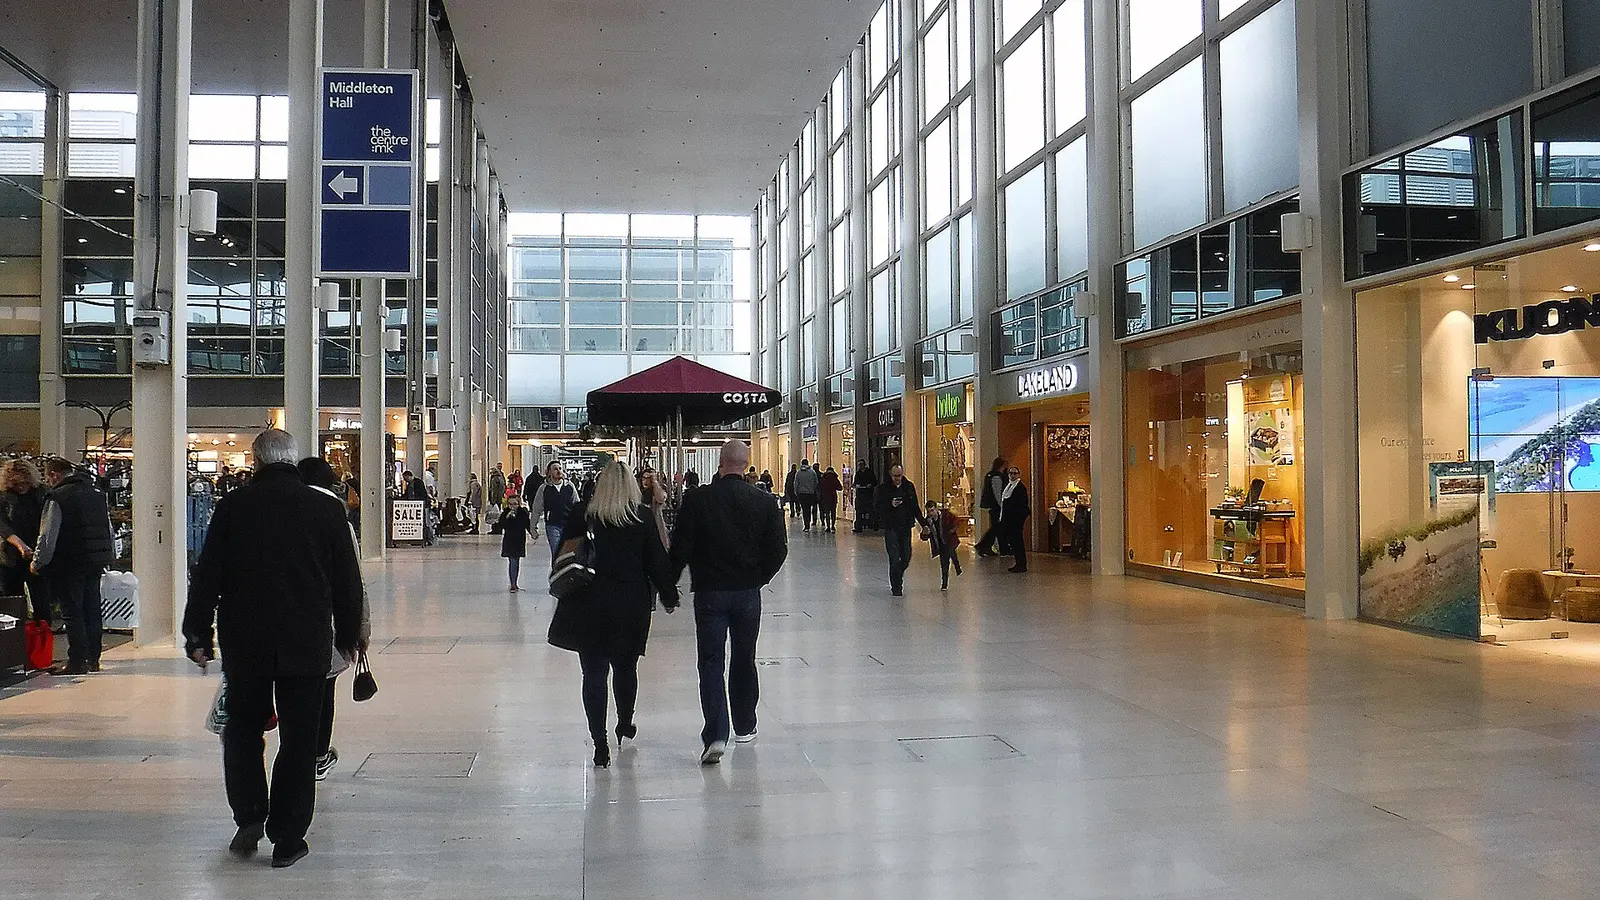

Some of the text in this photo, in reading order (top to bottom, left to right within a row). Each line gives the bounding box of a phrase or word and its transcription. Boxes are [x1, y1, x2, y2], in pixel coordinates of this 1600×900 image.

[330, 82, 394, 94] Middleton
[330, 97, 353, 108] Hall
[370, 125, 391, 137] the
[370, 135, 409, 146] centre
[371, 143, 394, 154] :mk
[1017, 364, 1078, 398] LAKELAND
[722, 392, 768, 405] COSTA
[878, 408, 894, 427] COSTA
[1380, 437, 1395, 447] Our
[394, 509, 422, 520] SALE
